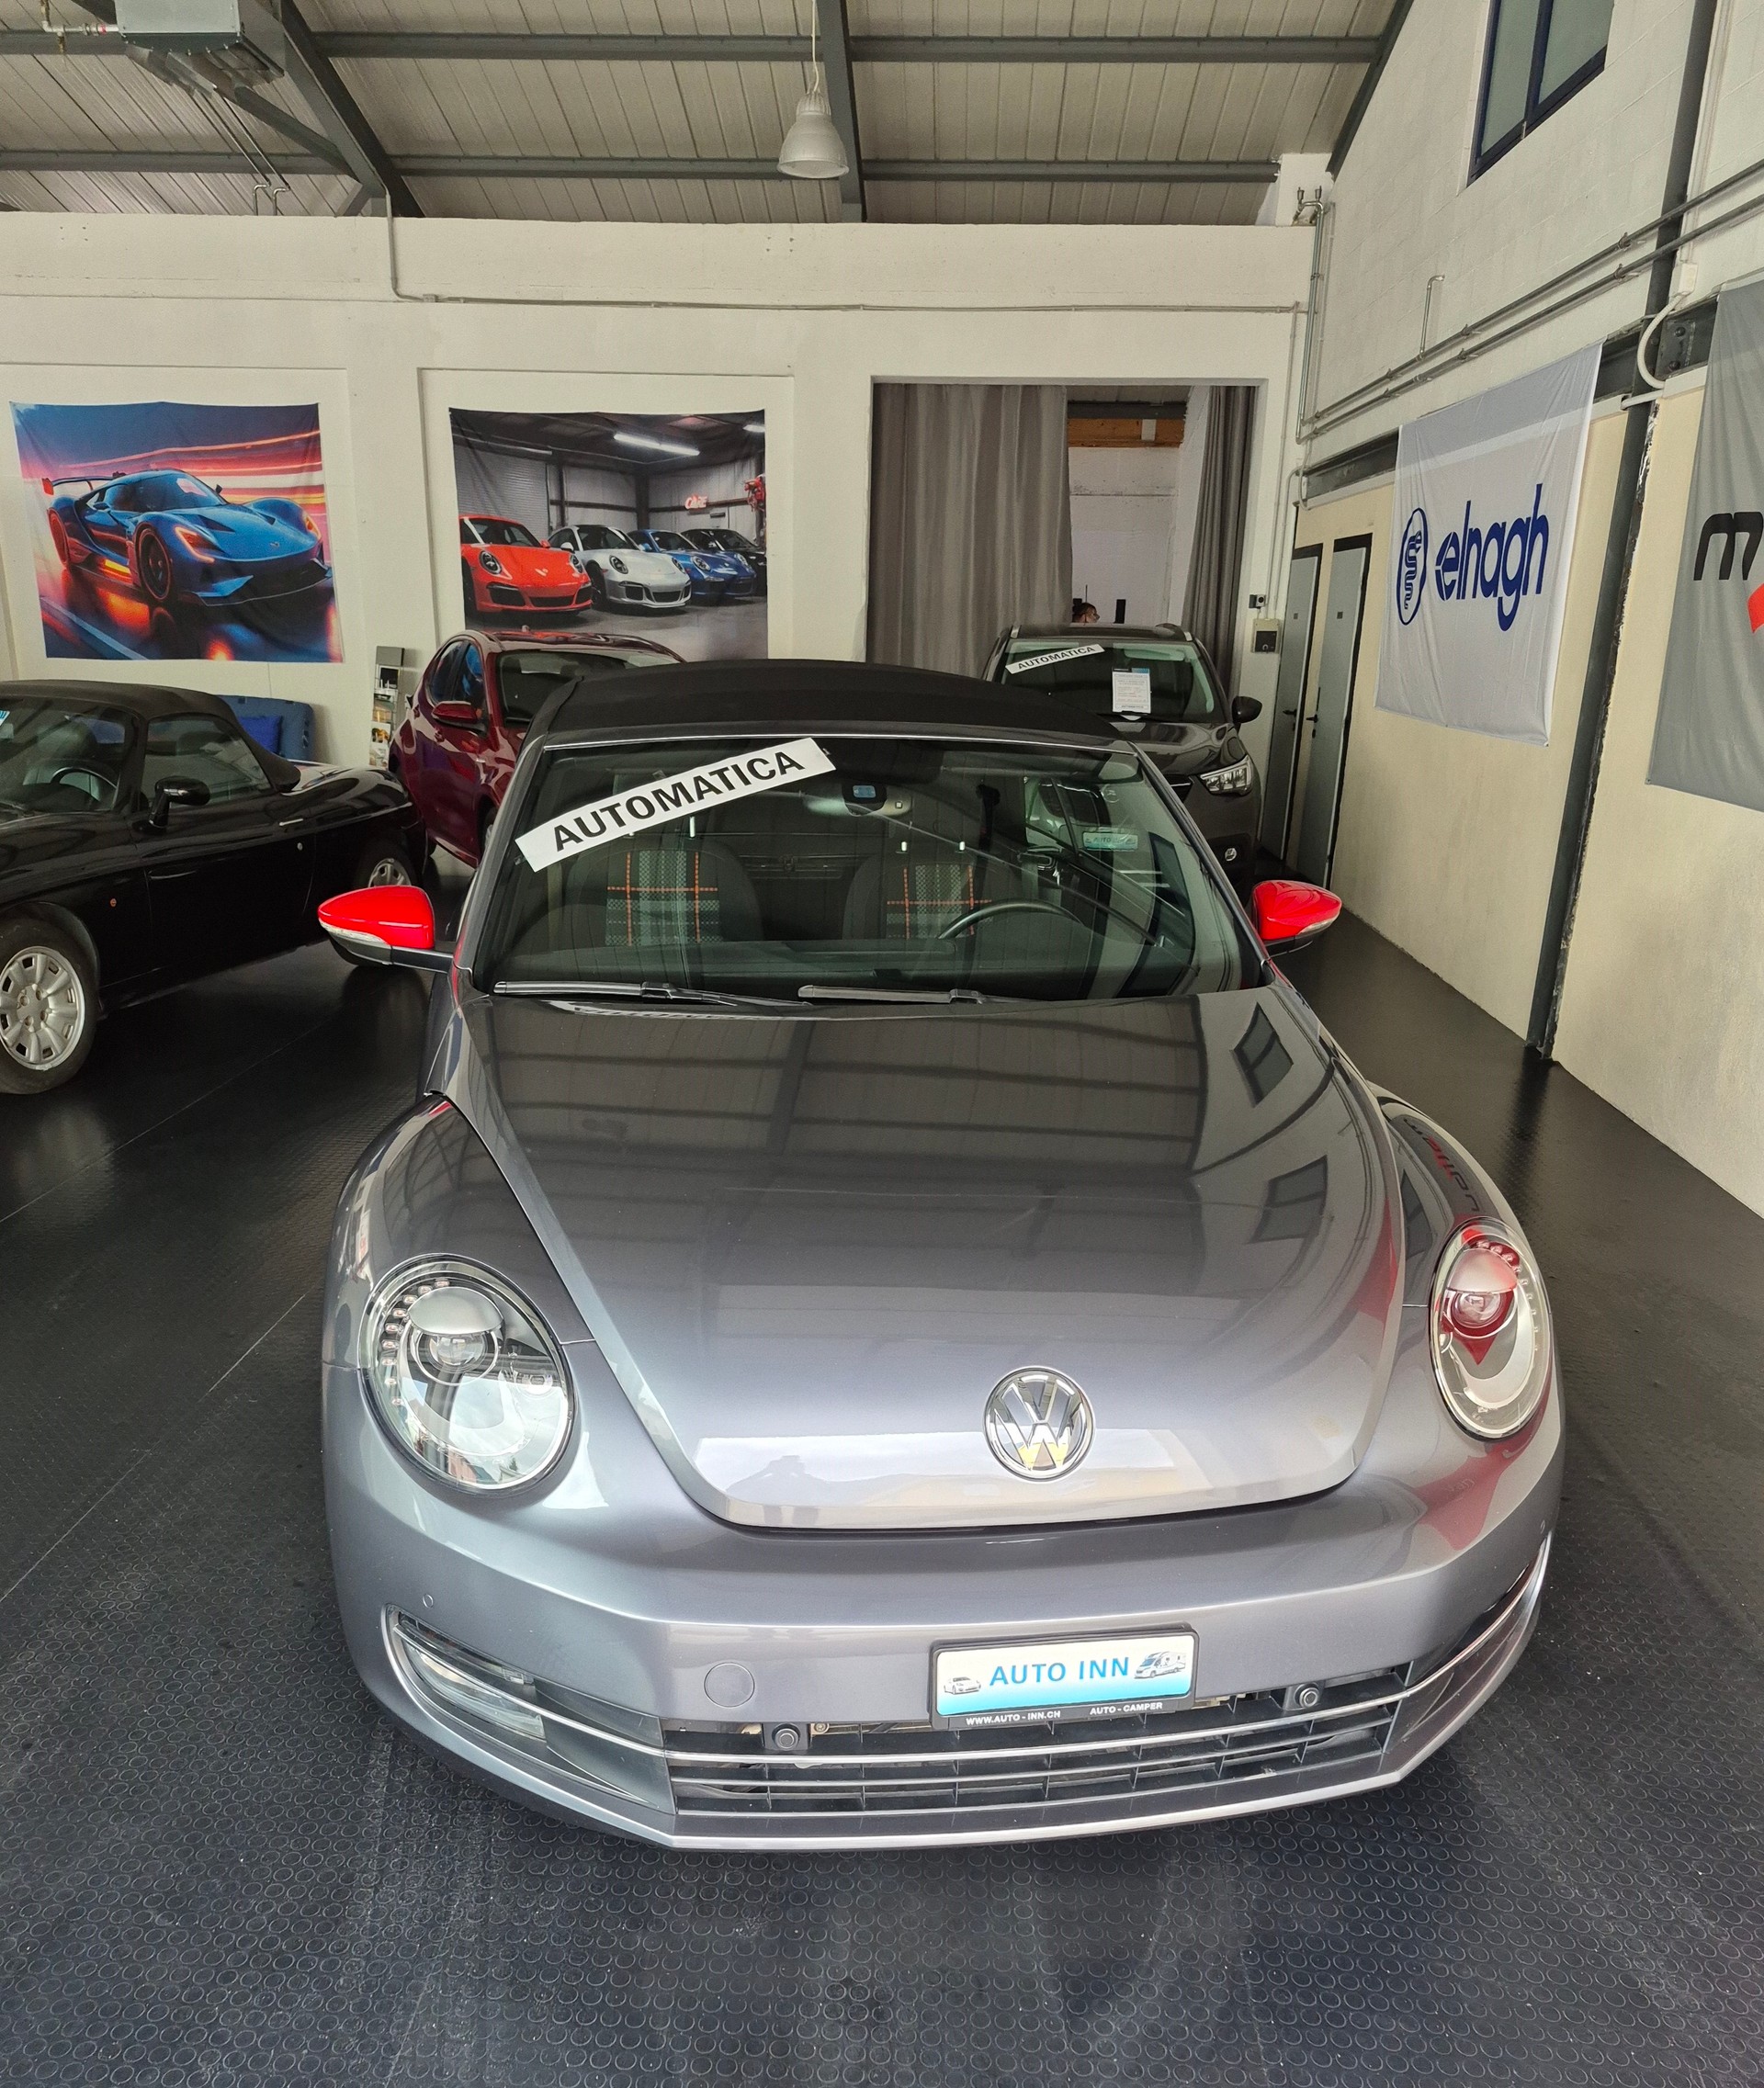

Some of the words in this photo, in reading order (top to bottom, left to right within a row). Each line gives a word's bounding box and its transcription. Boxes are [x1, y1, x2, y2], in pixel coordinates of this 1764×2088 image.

[1435, 483, 1549, 631] elnagh
[1018, 647, 1095, 669] AUTOMATICA
[554, 751, 805, 852] AUTOMATICA
[989, 1662, 1066, 1687] AUTO
[1079, 1656, 1129, 1680] INN
[1123, 1702, 1163, 1713] CAMPER
